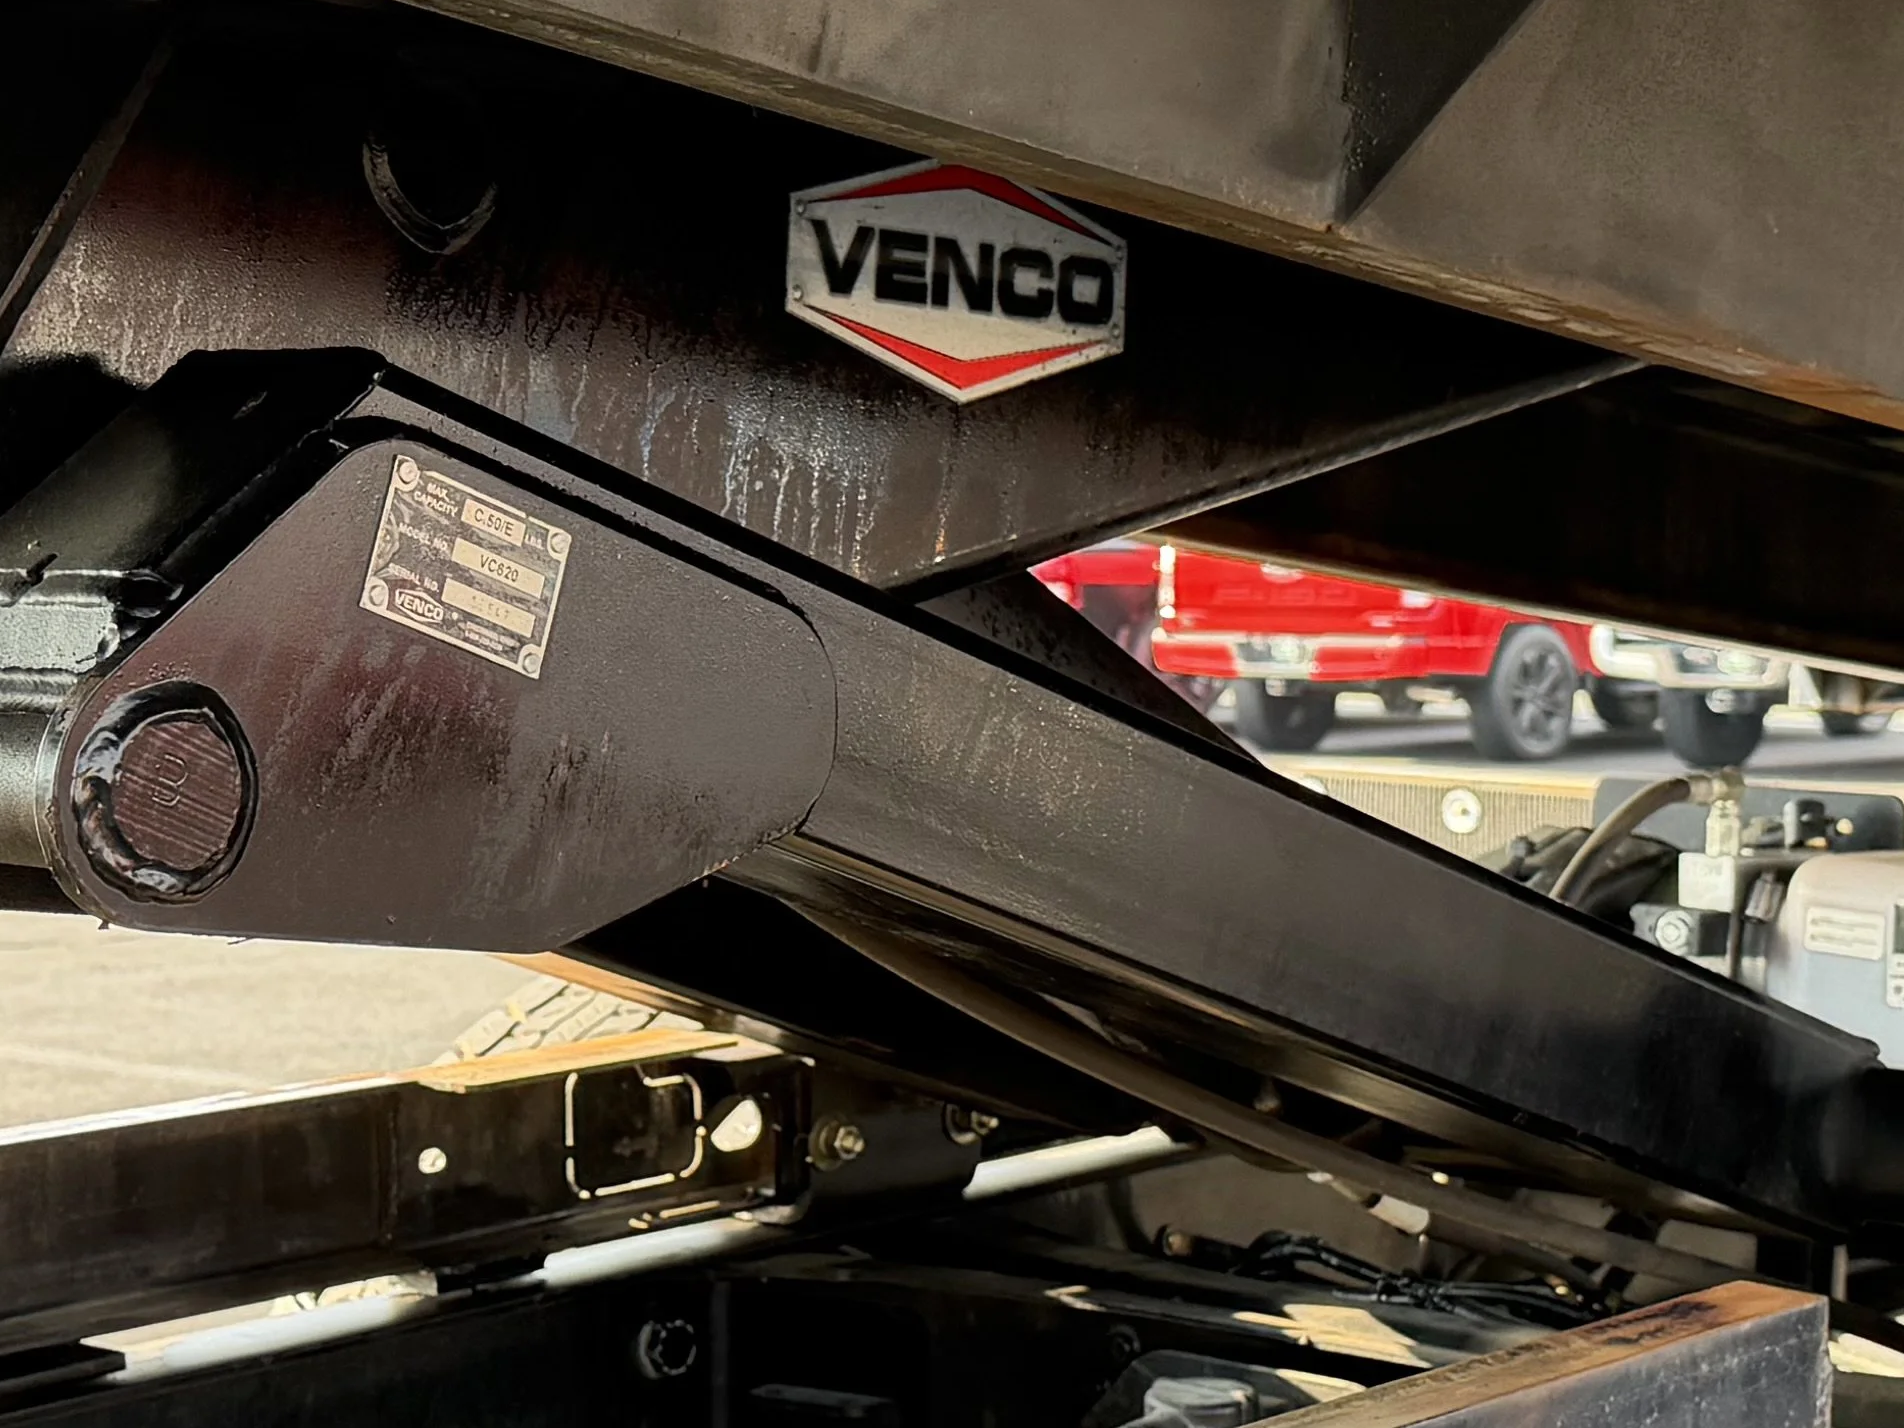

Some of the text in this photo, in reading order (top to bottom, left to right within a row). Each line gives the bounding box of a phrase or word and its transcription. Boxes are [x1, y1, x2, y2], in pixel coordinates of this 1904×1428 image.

[809, 219, 1114, 325] VENCO
[474, 508, 514, 537] C.50/E
[397, 593, 444, 621] VENCO
